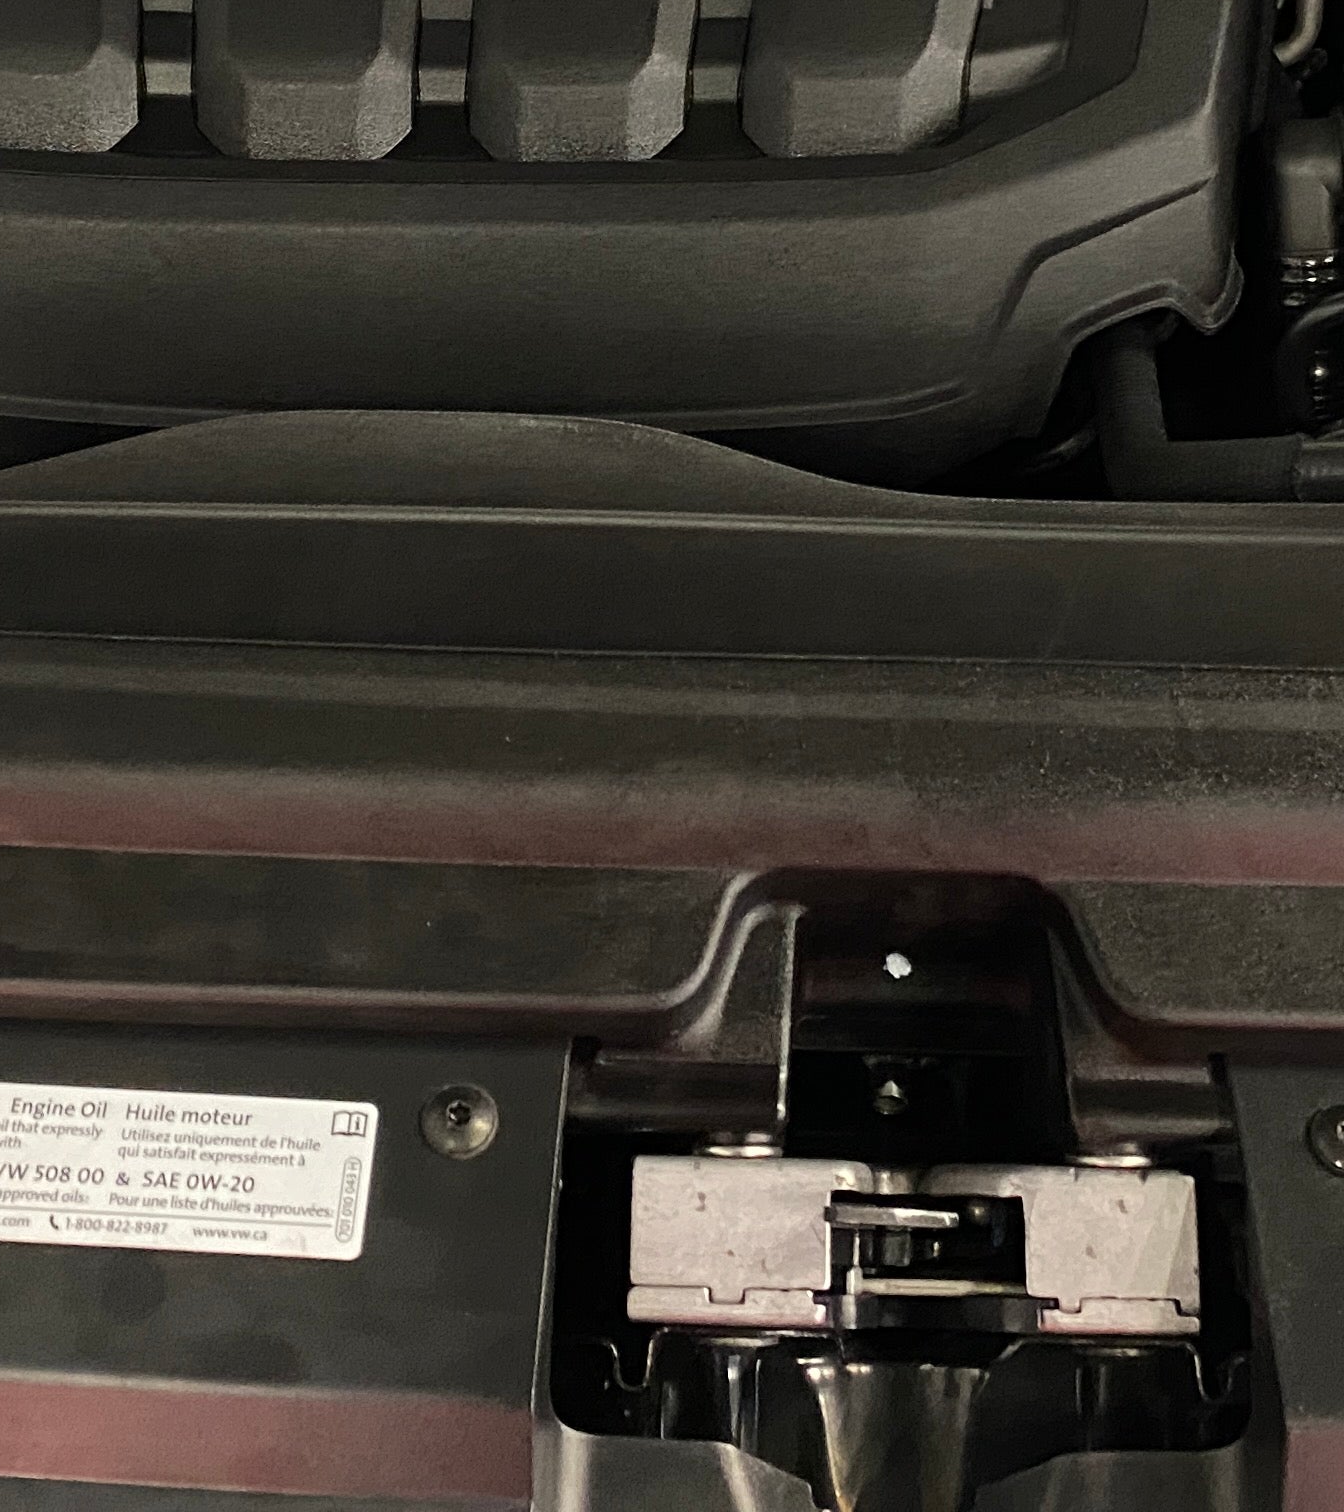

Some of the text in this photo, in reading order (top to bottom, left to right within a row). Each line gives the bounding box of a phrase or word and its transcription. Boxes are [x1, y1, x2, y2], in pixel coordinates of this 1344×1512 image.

[10, 1097, 252, 1125] Engine Oil Huile moteur
[11, 1120, 39, 1133] that
[41, 1124, 103, 1140] expressly
[121, 1128, 320, 1151] Utilisez uniquement de l'huile
[117, 1144, 305, 1166] qui satisfait expressément à
[35, 1164, 71, 1182] 508
[77, 1167, 104, 1184] 00
[115, 1172, 130, 1185] &
[142, 1171, 180, 1188] SAE
[186, 1173, 254, 1193] 0W-20
[61, 1189, 89, 1203] oils:
[192, 1228, 267, 1241] www.vw.ca
